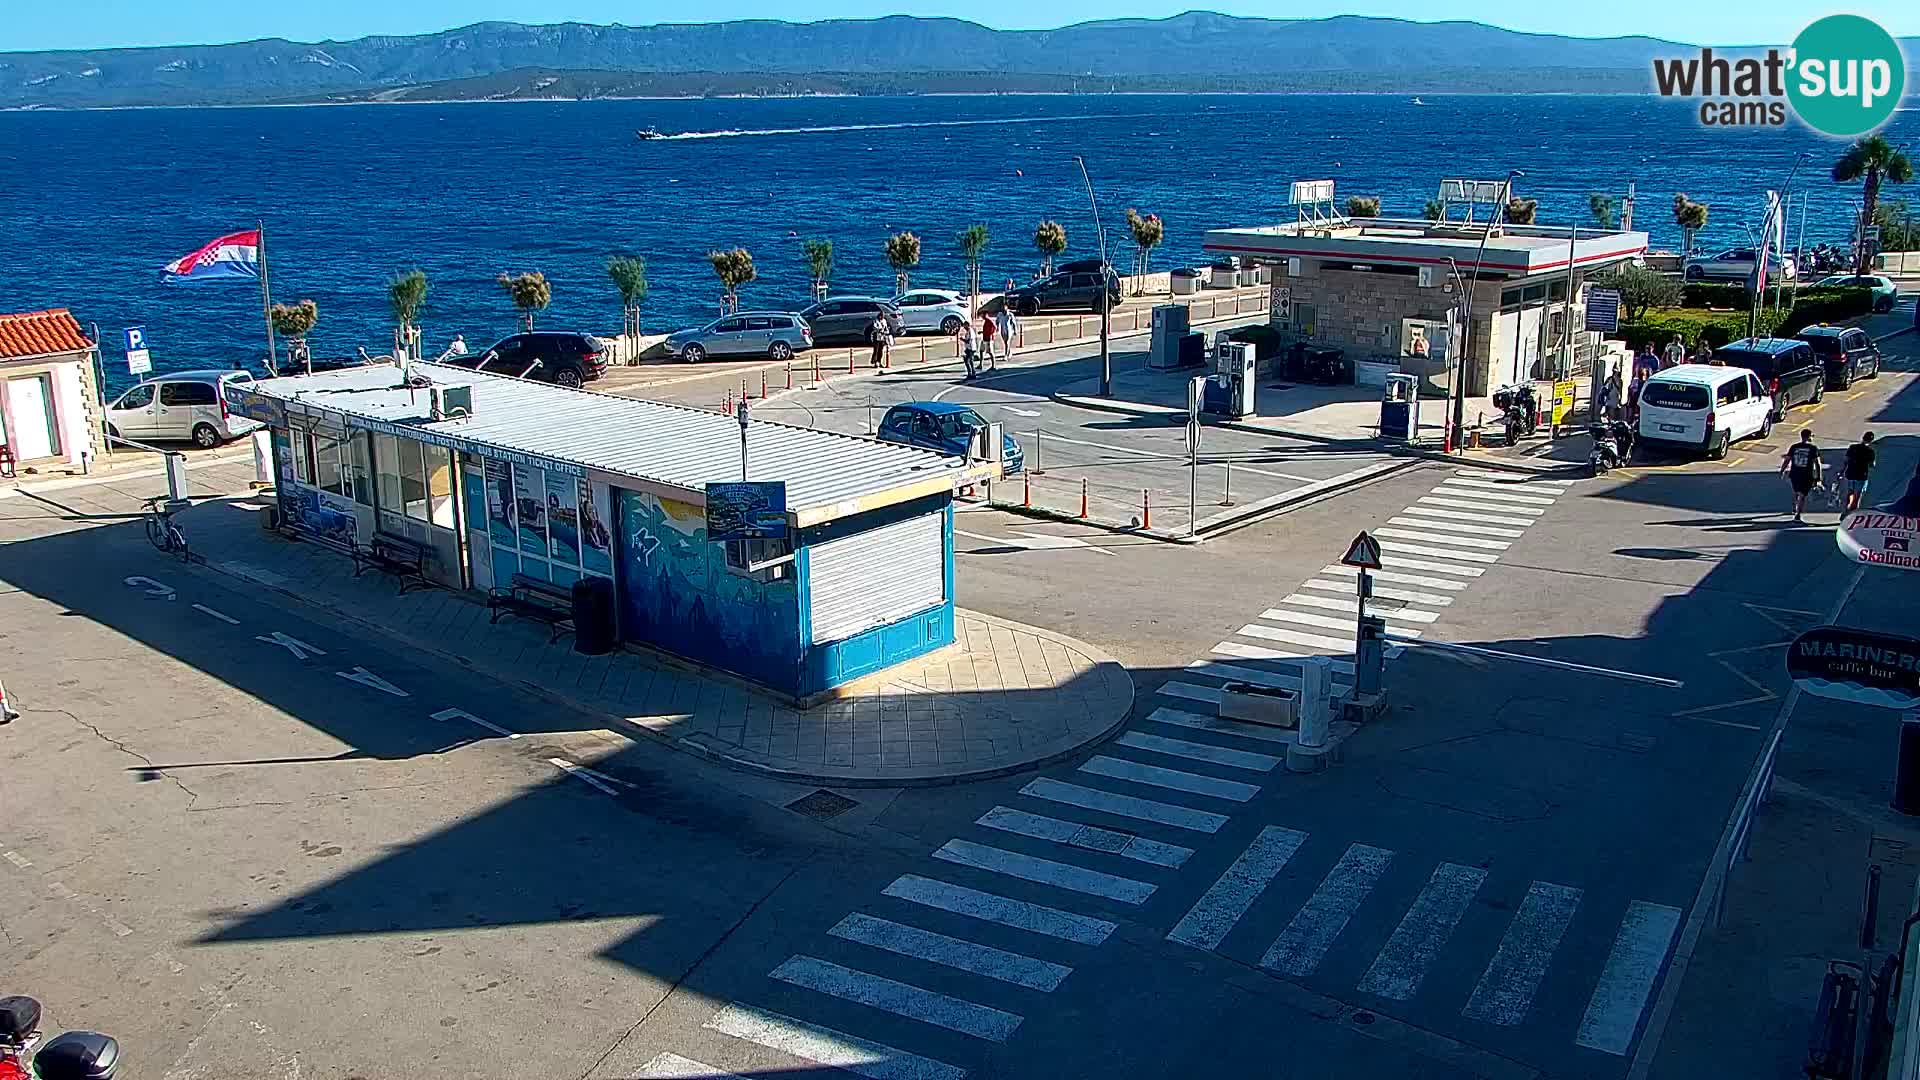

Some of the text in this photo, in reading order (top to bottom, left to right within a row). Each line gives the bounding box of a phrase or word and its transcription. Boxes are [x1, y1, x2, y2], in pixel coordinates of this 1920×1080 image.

[129, 330, 142, 349] P
[1668, 384, 1687, 392] TAXI
[436, 436, 467, 450] POSTAJA
[478, 445, 493, 457] BUS
[494, 449, 526, 465] STATION
[527, 456, 554, 470] TICKET
[555, 462, 582, 477] OFFICE
[1870, 664, 1897, 679] bar
